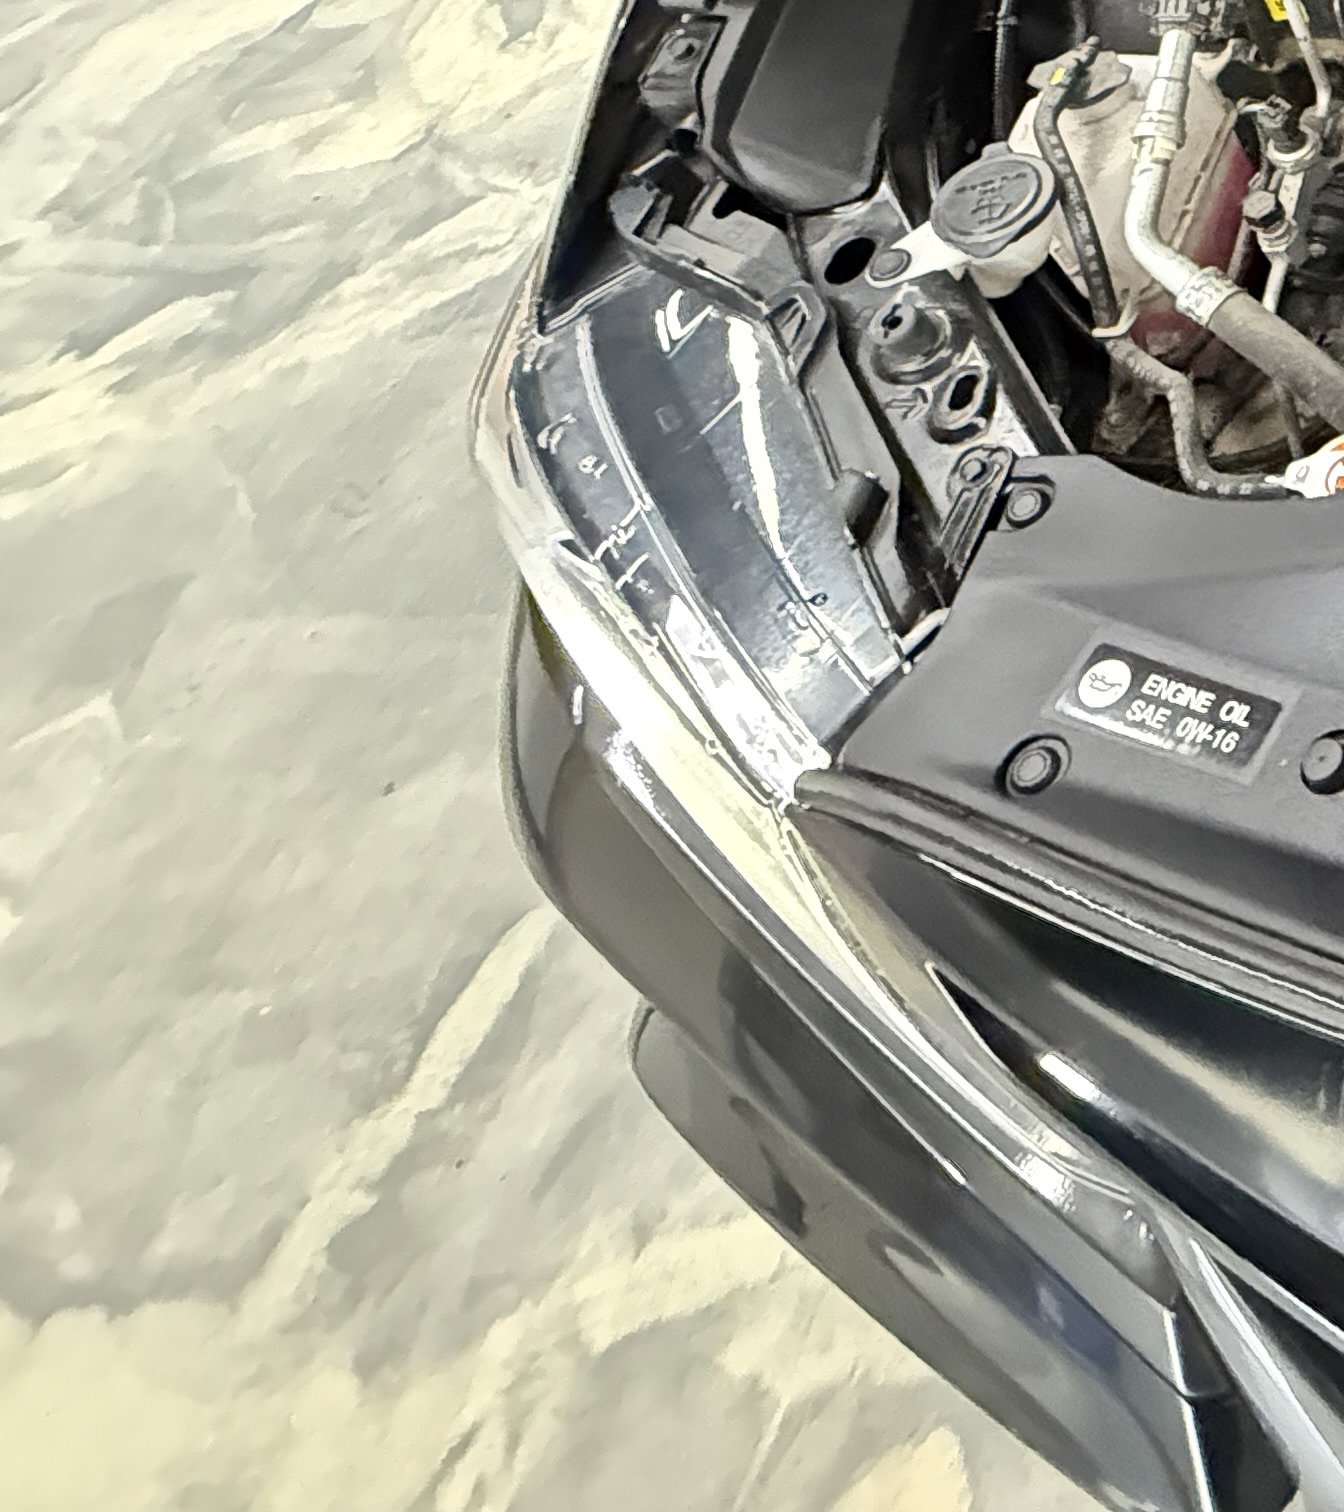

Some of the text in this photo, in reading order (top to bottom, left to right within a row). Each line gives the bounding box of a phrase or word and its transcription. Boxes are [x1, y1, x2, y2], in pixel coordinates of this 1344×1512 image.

[1125, 698, 1241, 754] SAE 0W-16
[1140, 673, 1252, 728] ENGINE OIL
